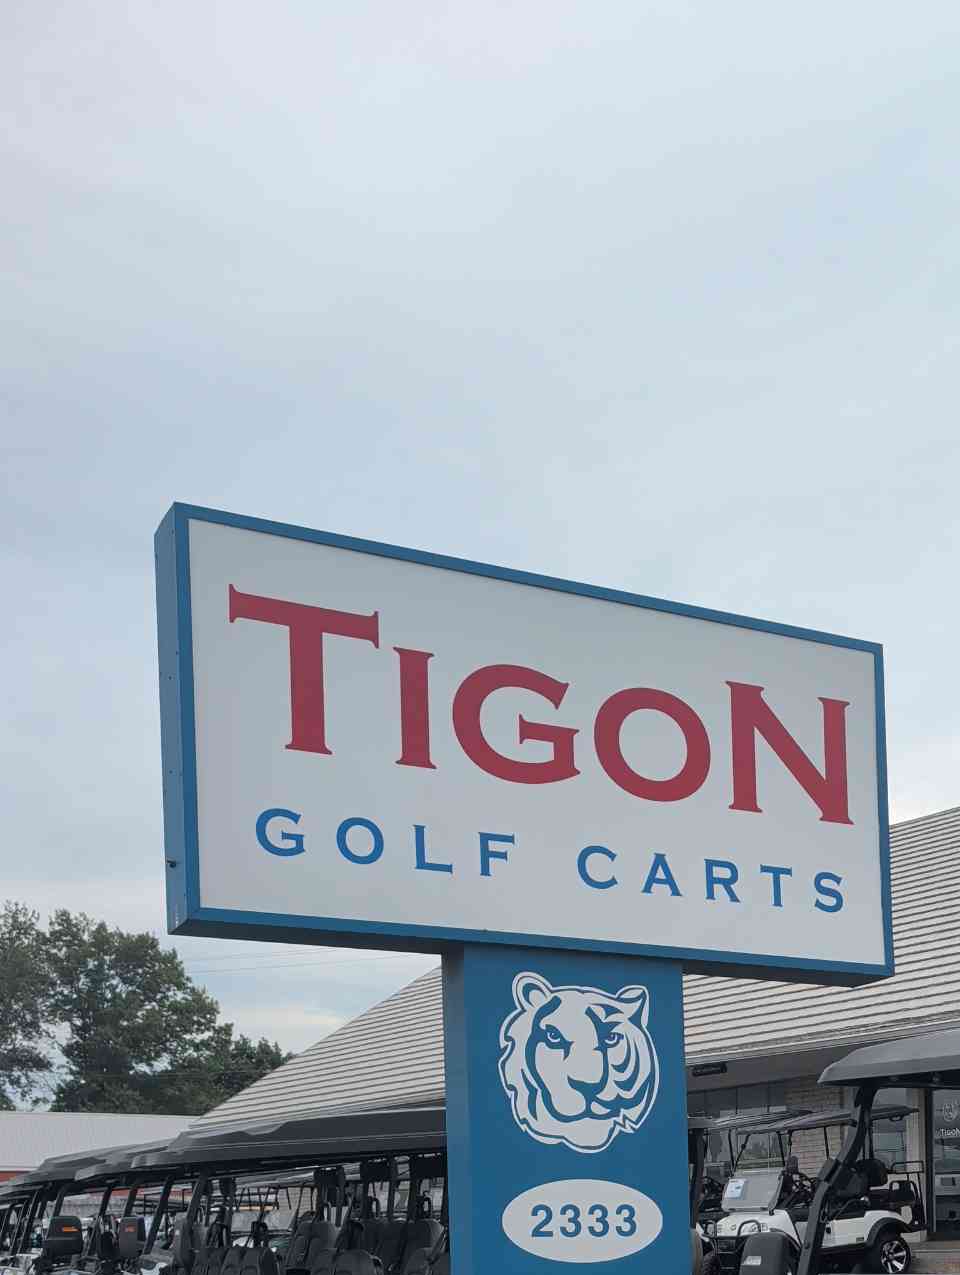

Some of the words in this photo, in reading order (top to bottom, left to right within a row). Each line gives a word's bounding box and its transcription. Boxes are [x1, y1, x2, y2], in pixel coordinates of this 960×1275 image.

[229, 583, 854, 825] TIGON
[255, 807, 514, 878] GOLF
[576, 845, 845, 914] CARTS
[531, 1203, 638, 1238] 2333
